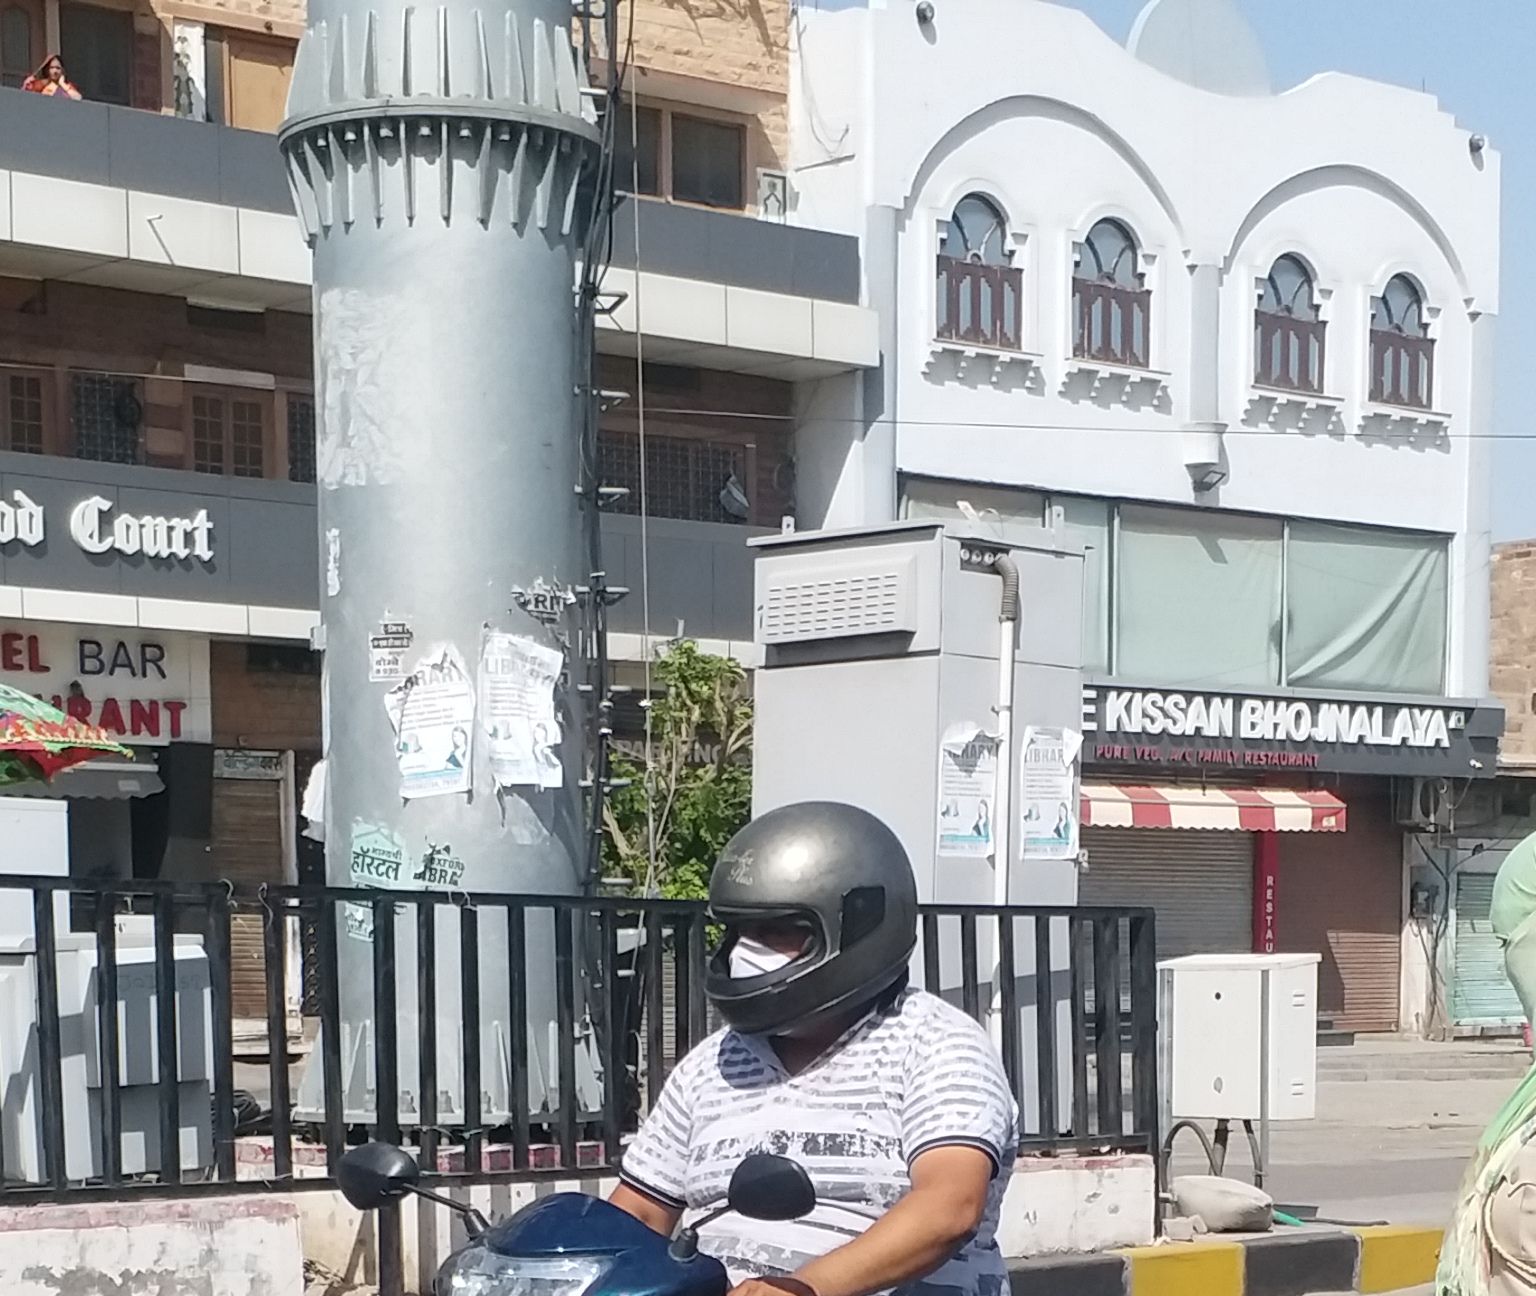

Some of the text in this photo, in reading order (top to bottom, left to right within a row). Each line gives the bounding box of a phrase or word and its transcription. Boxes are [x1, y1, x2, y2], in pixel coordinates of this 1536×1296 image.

[70, 495, 214, 562] Court
[79, 639, 167, 680] BAR
[1105, 690, 1234, 738] KISSAN
[1240, 698, 1451, 748] BHOJNALAYA
[1096, 744, 1130, 760] PURE
[1197, 749, 1241, 766] FAMILY
[1244, 752, 1320, 768] RESTAURANT
[351, 846, 402, 881] हॉस्टल
